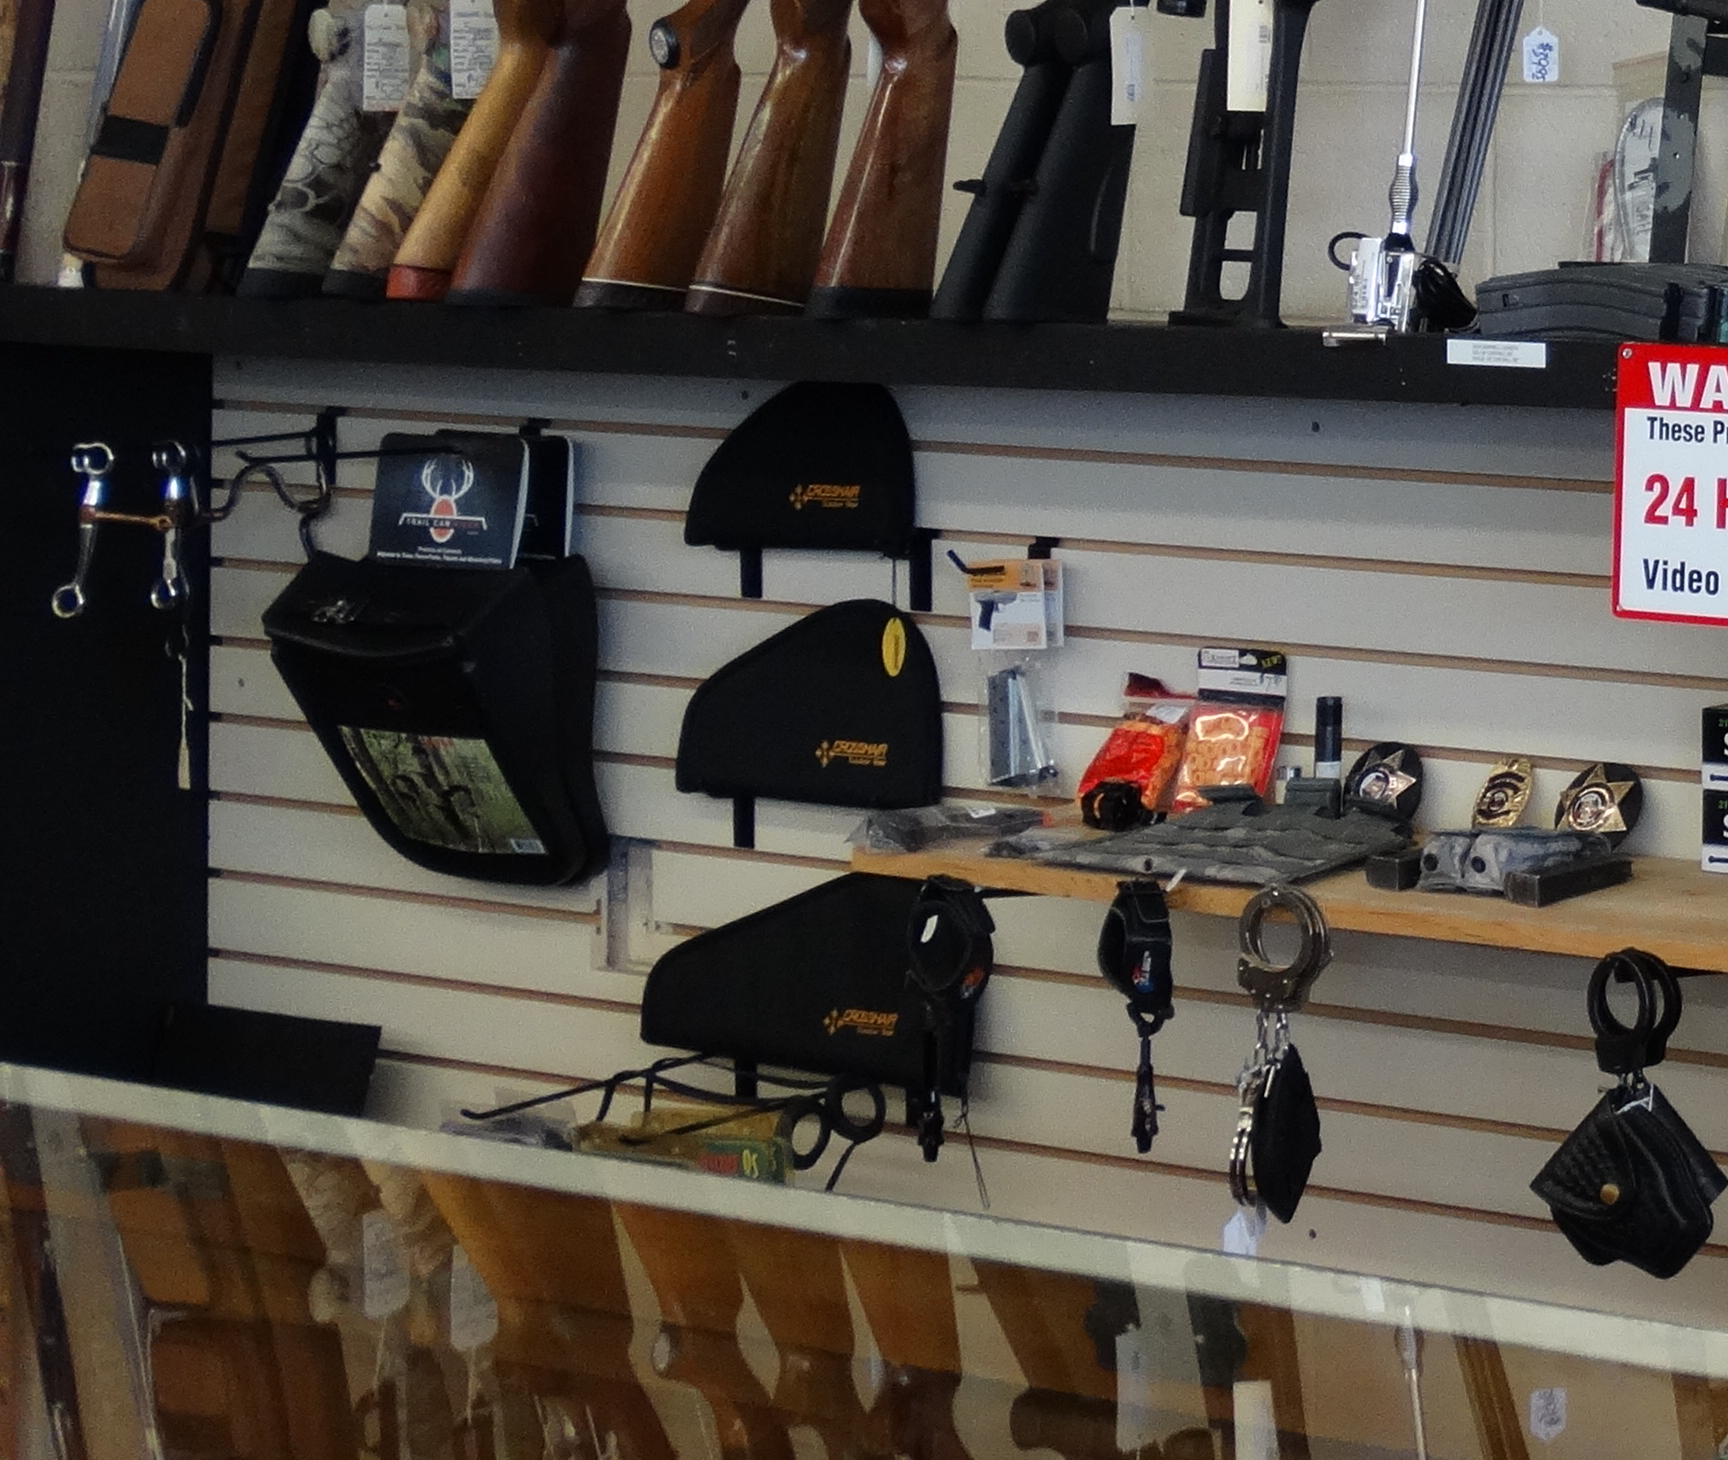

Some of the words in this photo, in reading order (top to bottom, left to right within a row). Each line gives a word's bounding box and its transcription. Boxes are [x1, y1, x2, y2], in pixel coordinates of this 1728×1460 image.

[1647, 416, 1705, 442] These
[1643, 473, 1699, 528] 24
[1642, 558, 1720, 597] Video
